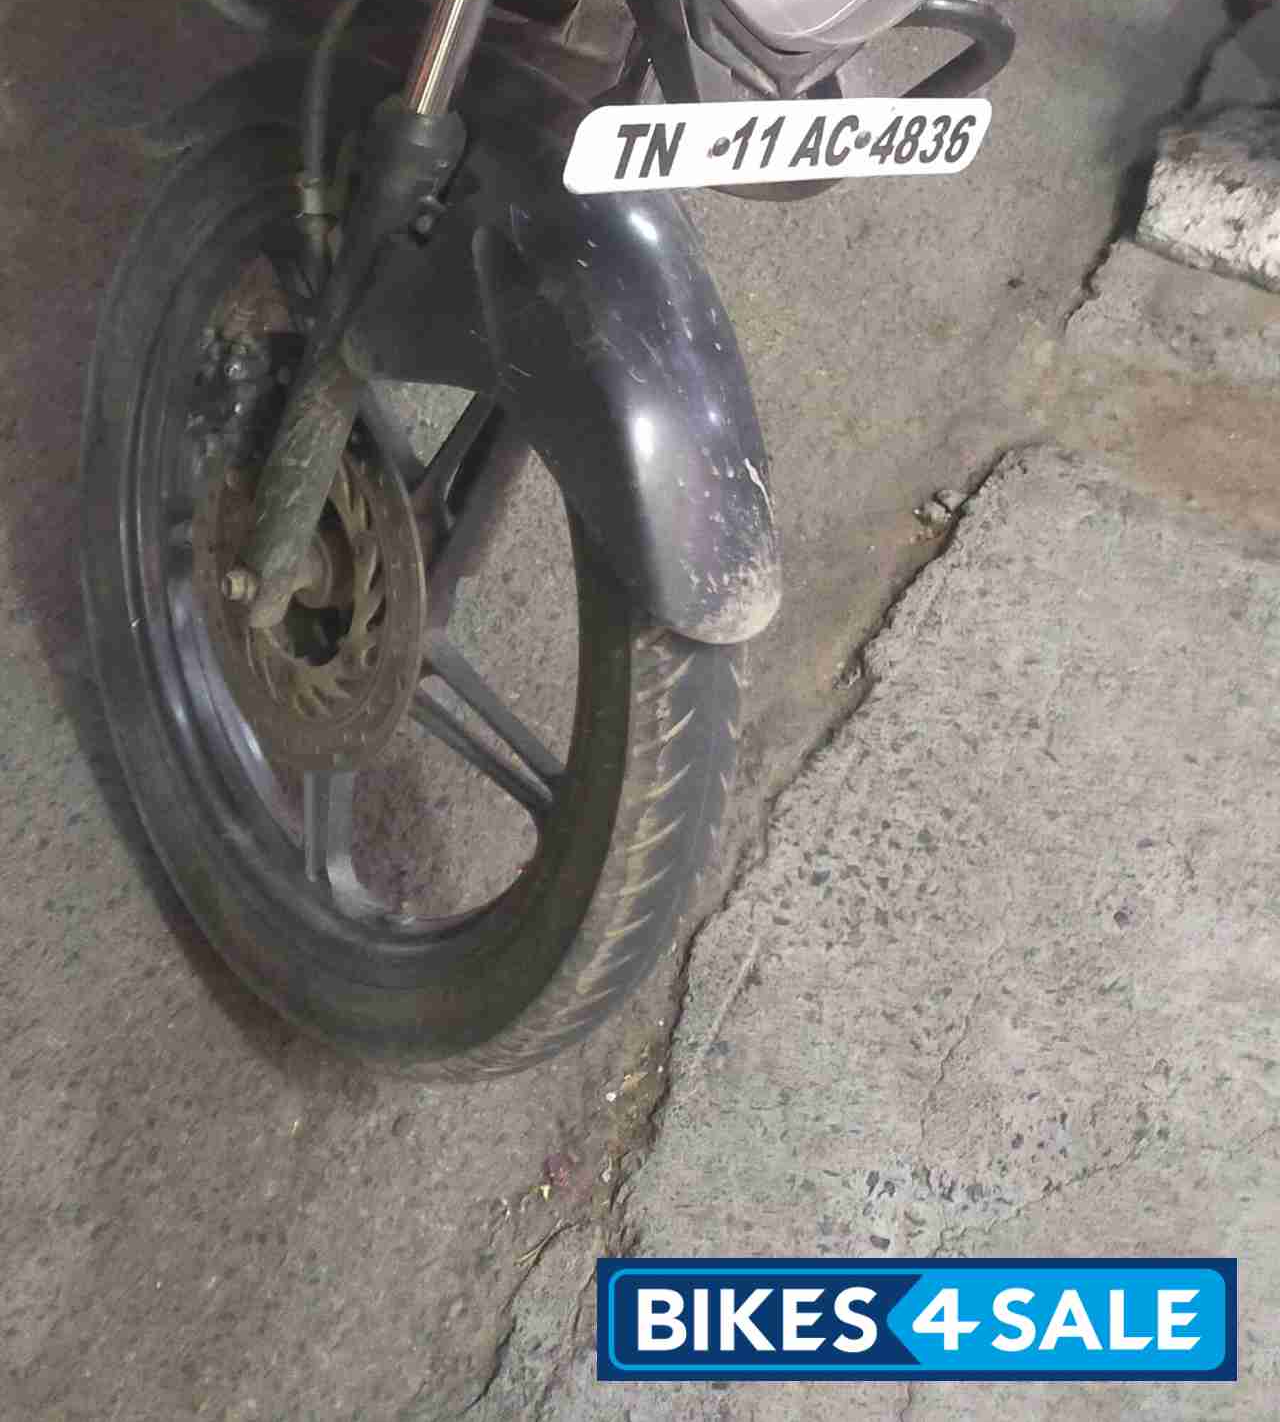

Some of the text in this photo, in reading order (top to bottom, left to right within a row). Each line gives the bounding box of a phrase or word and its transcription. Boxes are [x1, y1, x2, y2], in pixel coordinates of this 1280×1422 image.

[614, 114, 977, 180] TN 11 AC 4836
